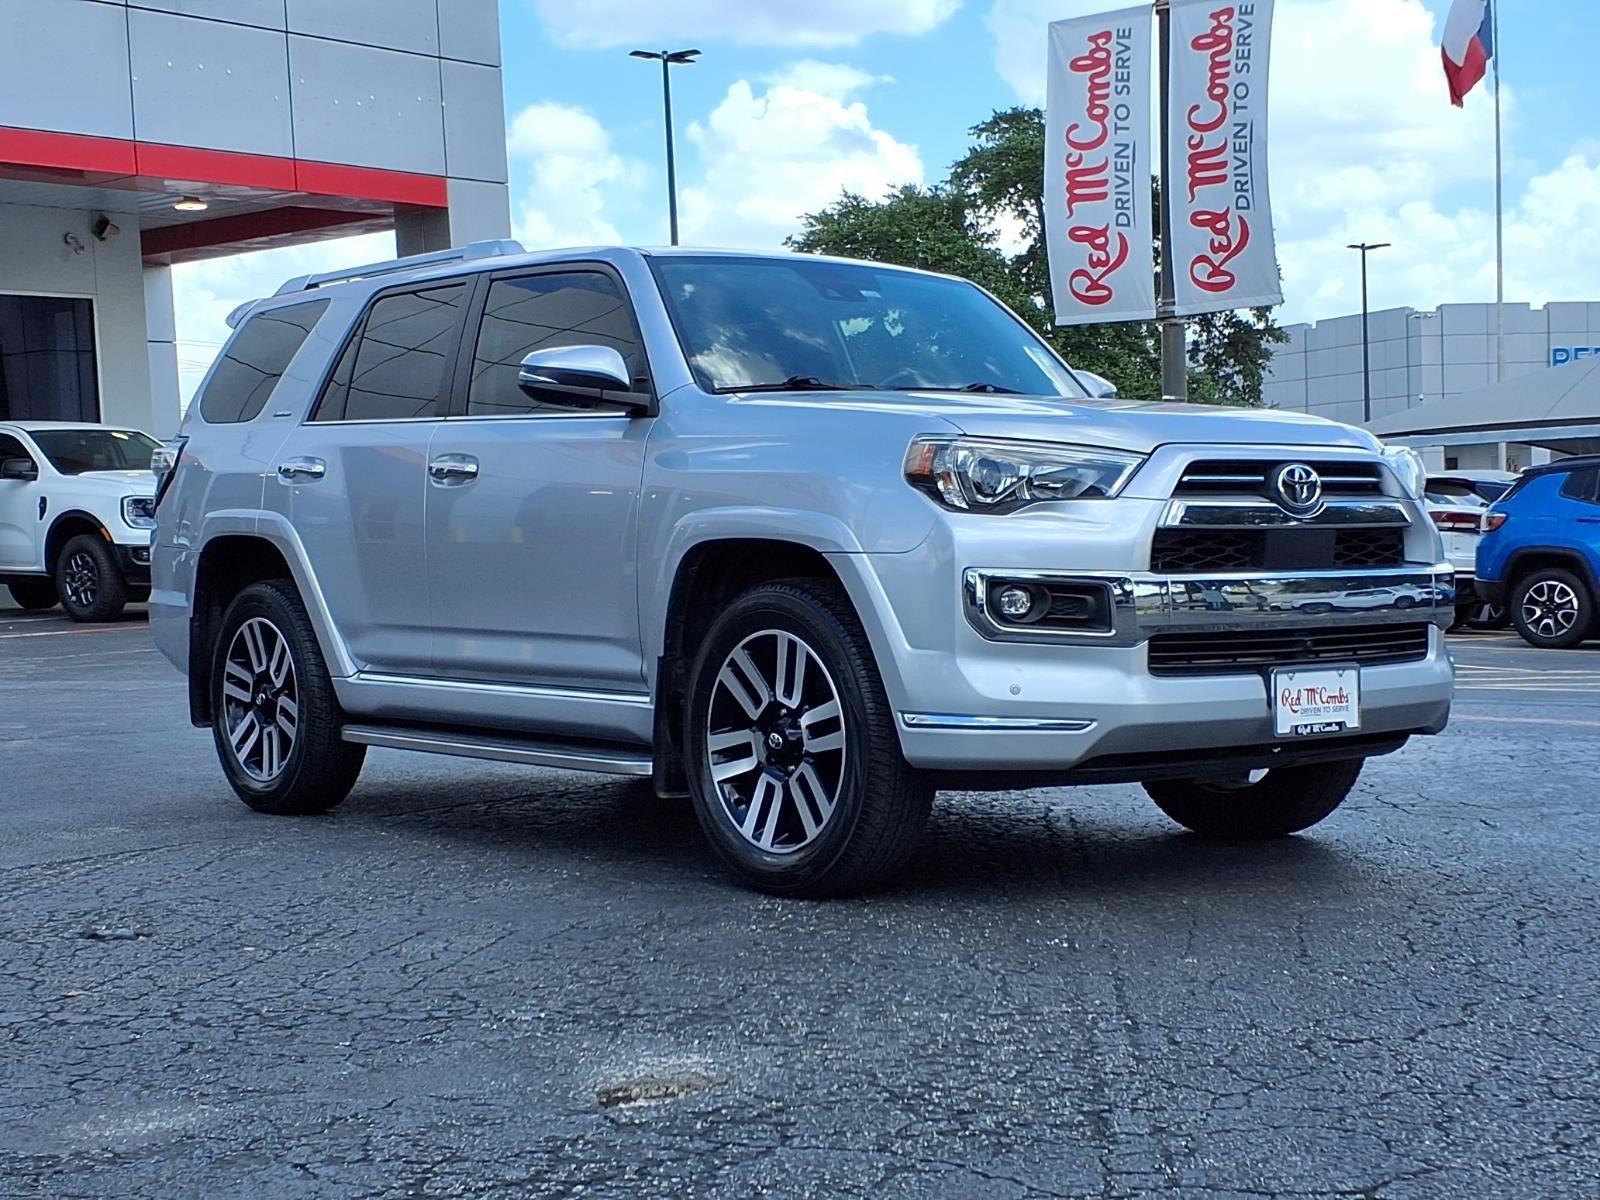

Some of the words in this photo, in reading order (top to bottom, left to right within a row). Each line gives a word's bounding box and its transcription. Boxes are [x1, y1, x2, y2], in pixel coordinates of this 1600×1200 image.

[1114, 26, 1132, 96] SERVE
[1233, 3, 1255, 75] SERVE
[1065, 30, 1113, 219] McCombs
[1114, 103, 1131, 135] TO
[1187, 6, 1235, 204] McCombs
[1233, 81, 1249, 115] TO
[1114, 142, 1131, 228] DRIVEN
[1233, 122, 1250, 211] DRIVEN
[1068, 223, 1129, 305] Red
[1189, 205, 1250, 293] Red
[1282, 688, 1302, 713] Red
[1303, 686, 1349, 705] McCombs
[1300, 706, 1321, 715] DRIVEN
[1332, 705, 1350, 713] SERVE
